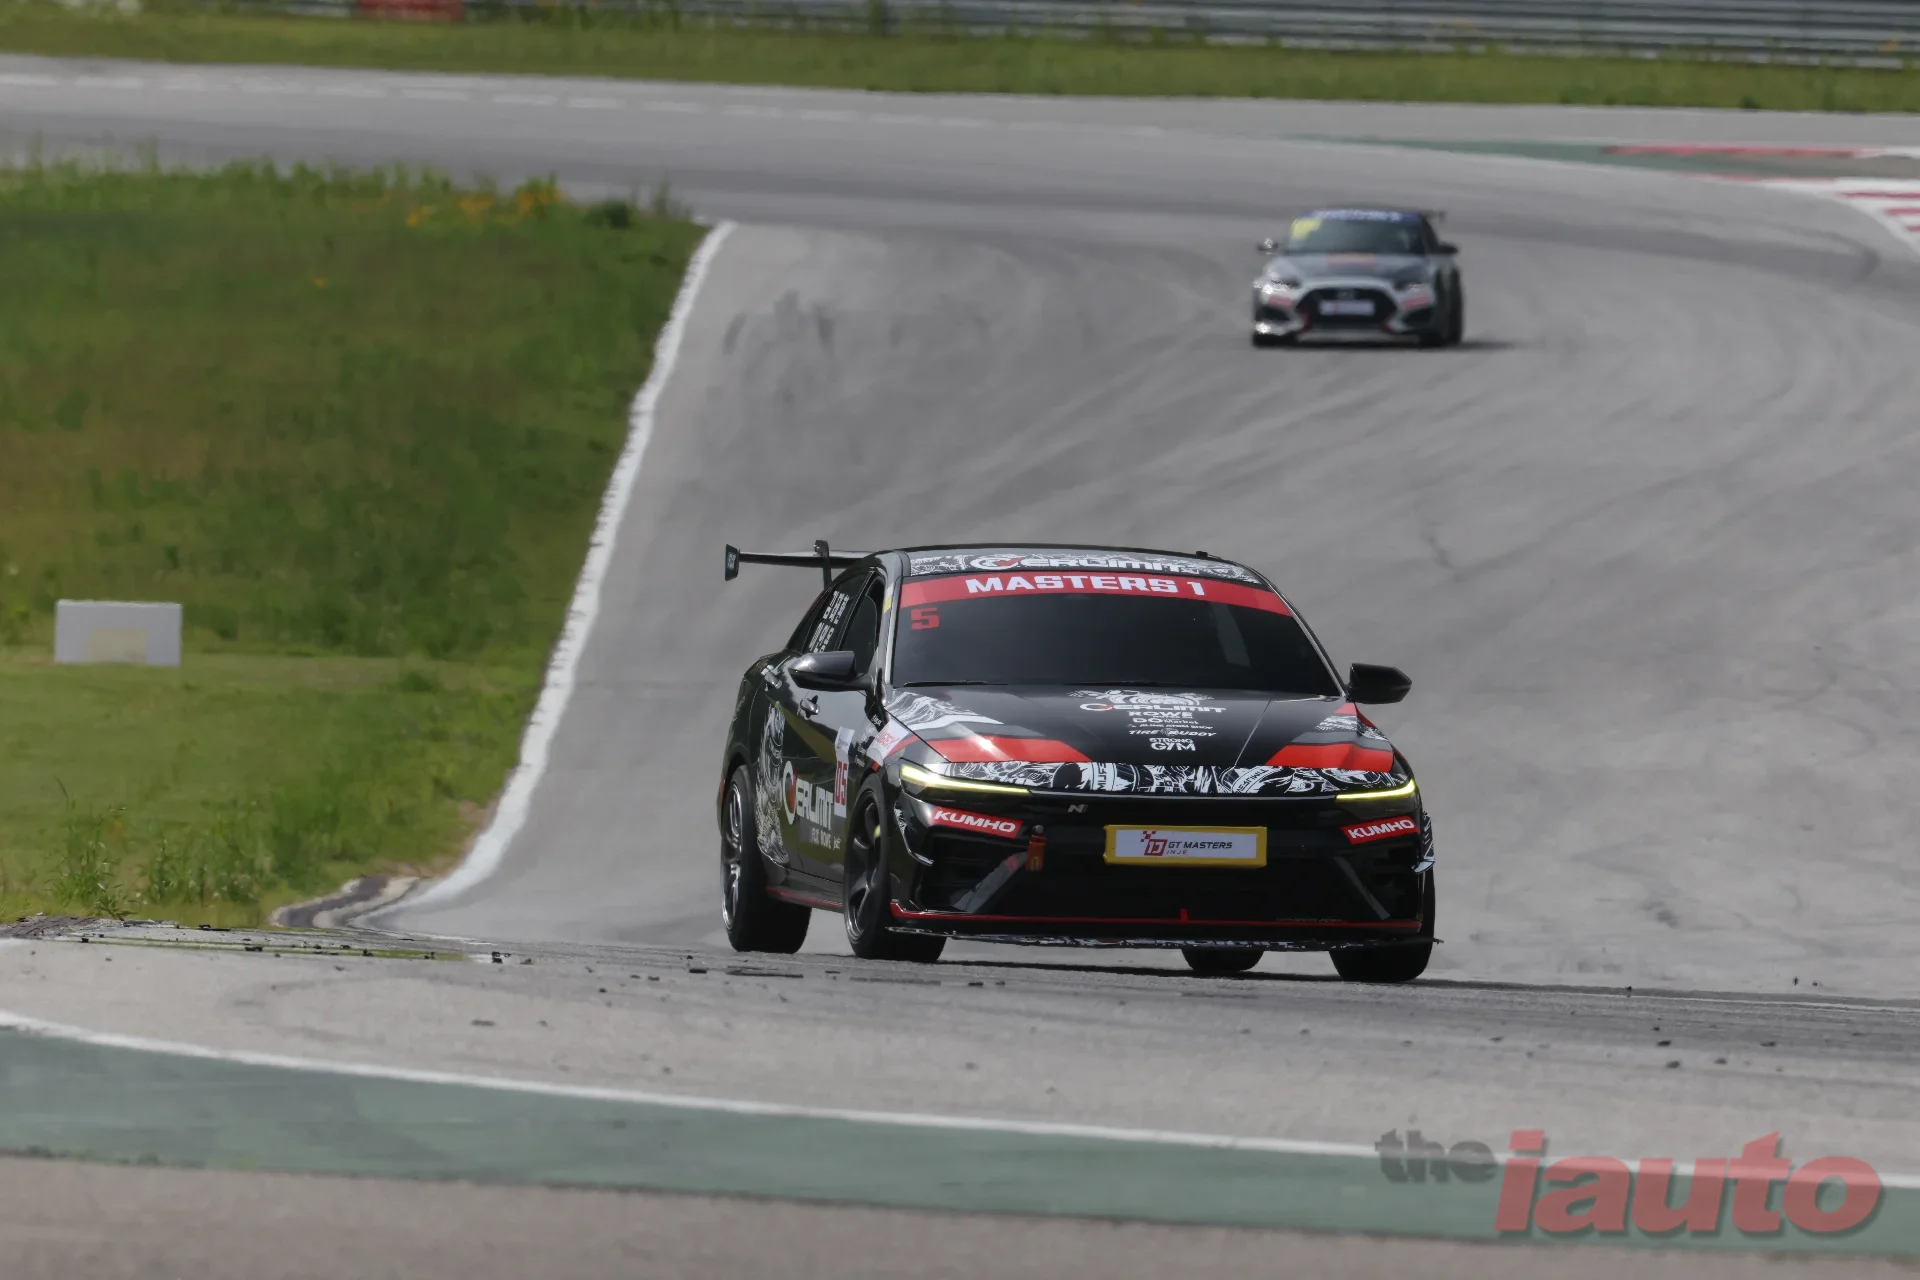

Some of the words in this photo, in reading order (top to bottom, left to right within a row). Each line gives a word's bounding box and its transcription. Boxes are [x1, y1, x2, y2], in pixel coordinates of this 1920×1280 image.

[965, 575, 1179, 594] MASTERS
[1187, 581, 1206, 596] 1
[911, 607, 940, 630] 5
[1151, 742, 1196, 752] GYM
[934, 810, 1016, 833] KUMHO
[1347, 819, 1415, 839] KUMHO
[1168, 841, 1182, 849] GT
[1184, 841, 1233, 849] MASTERS
